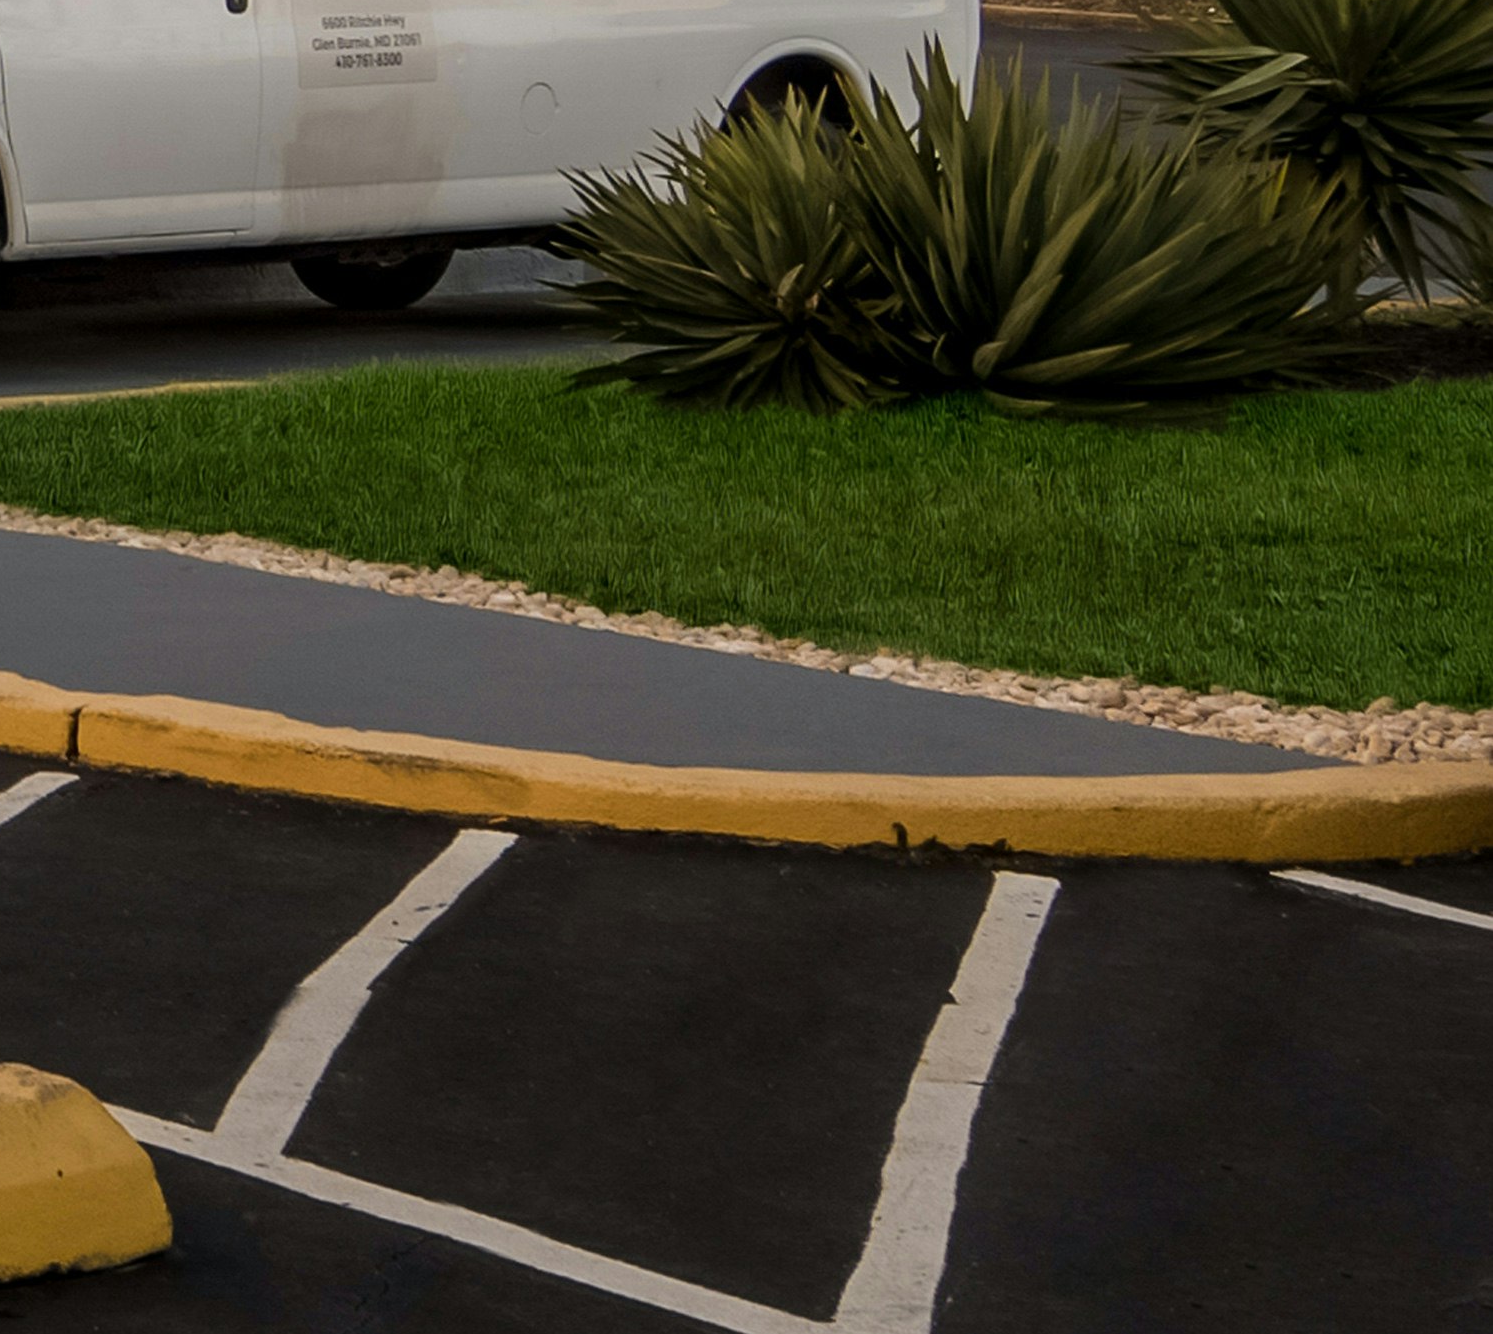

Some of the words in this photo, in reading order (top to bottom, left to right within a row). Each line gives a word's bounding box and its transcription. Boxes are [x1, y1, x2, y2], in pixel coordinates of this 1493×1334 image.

[384, 14, 406, 30] Hwy
[312, 37, 336, 52] Glen
[374, 34, 391, 48] MD
